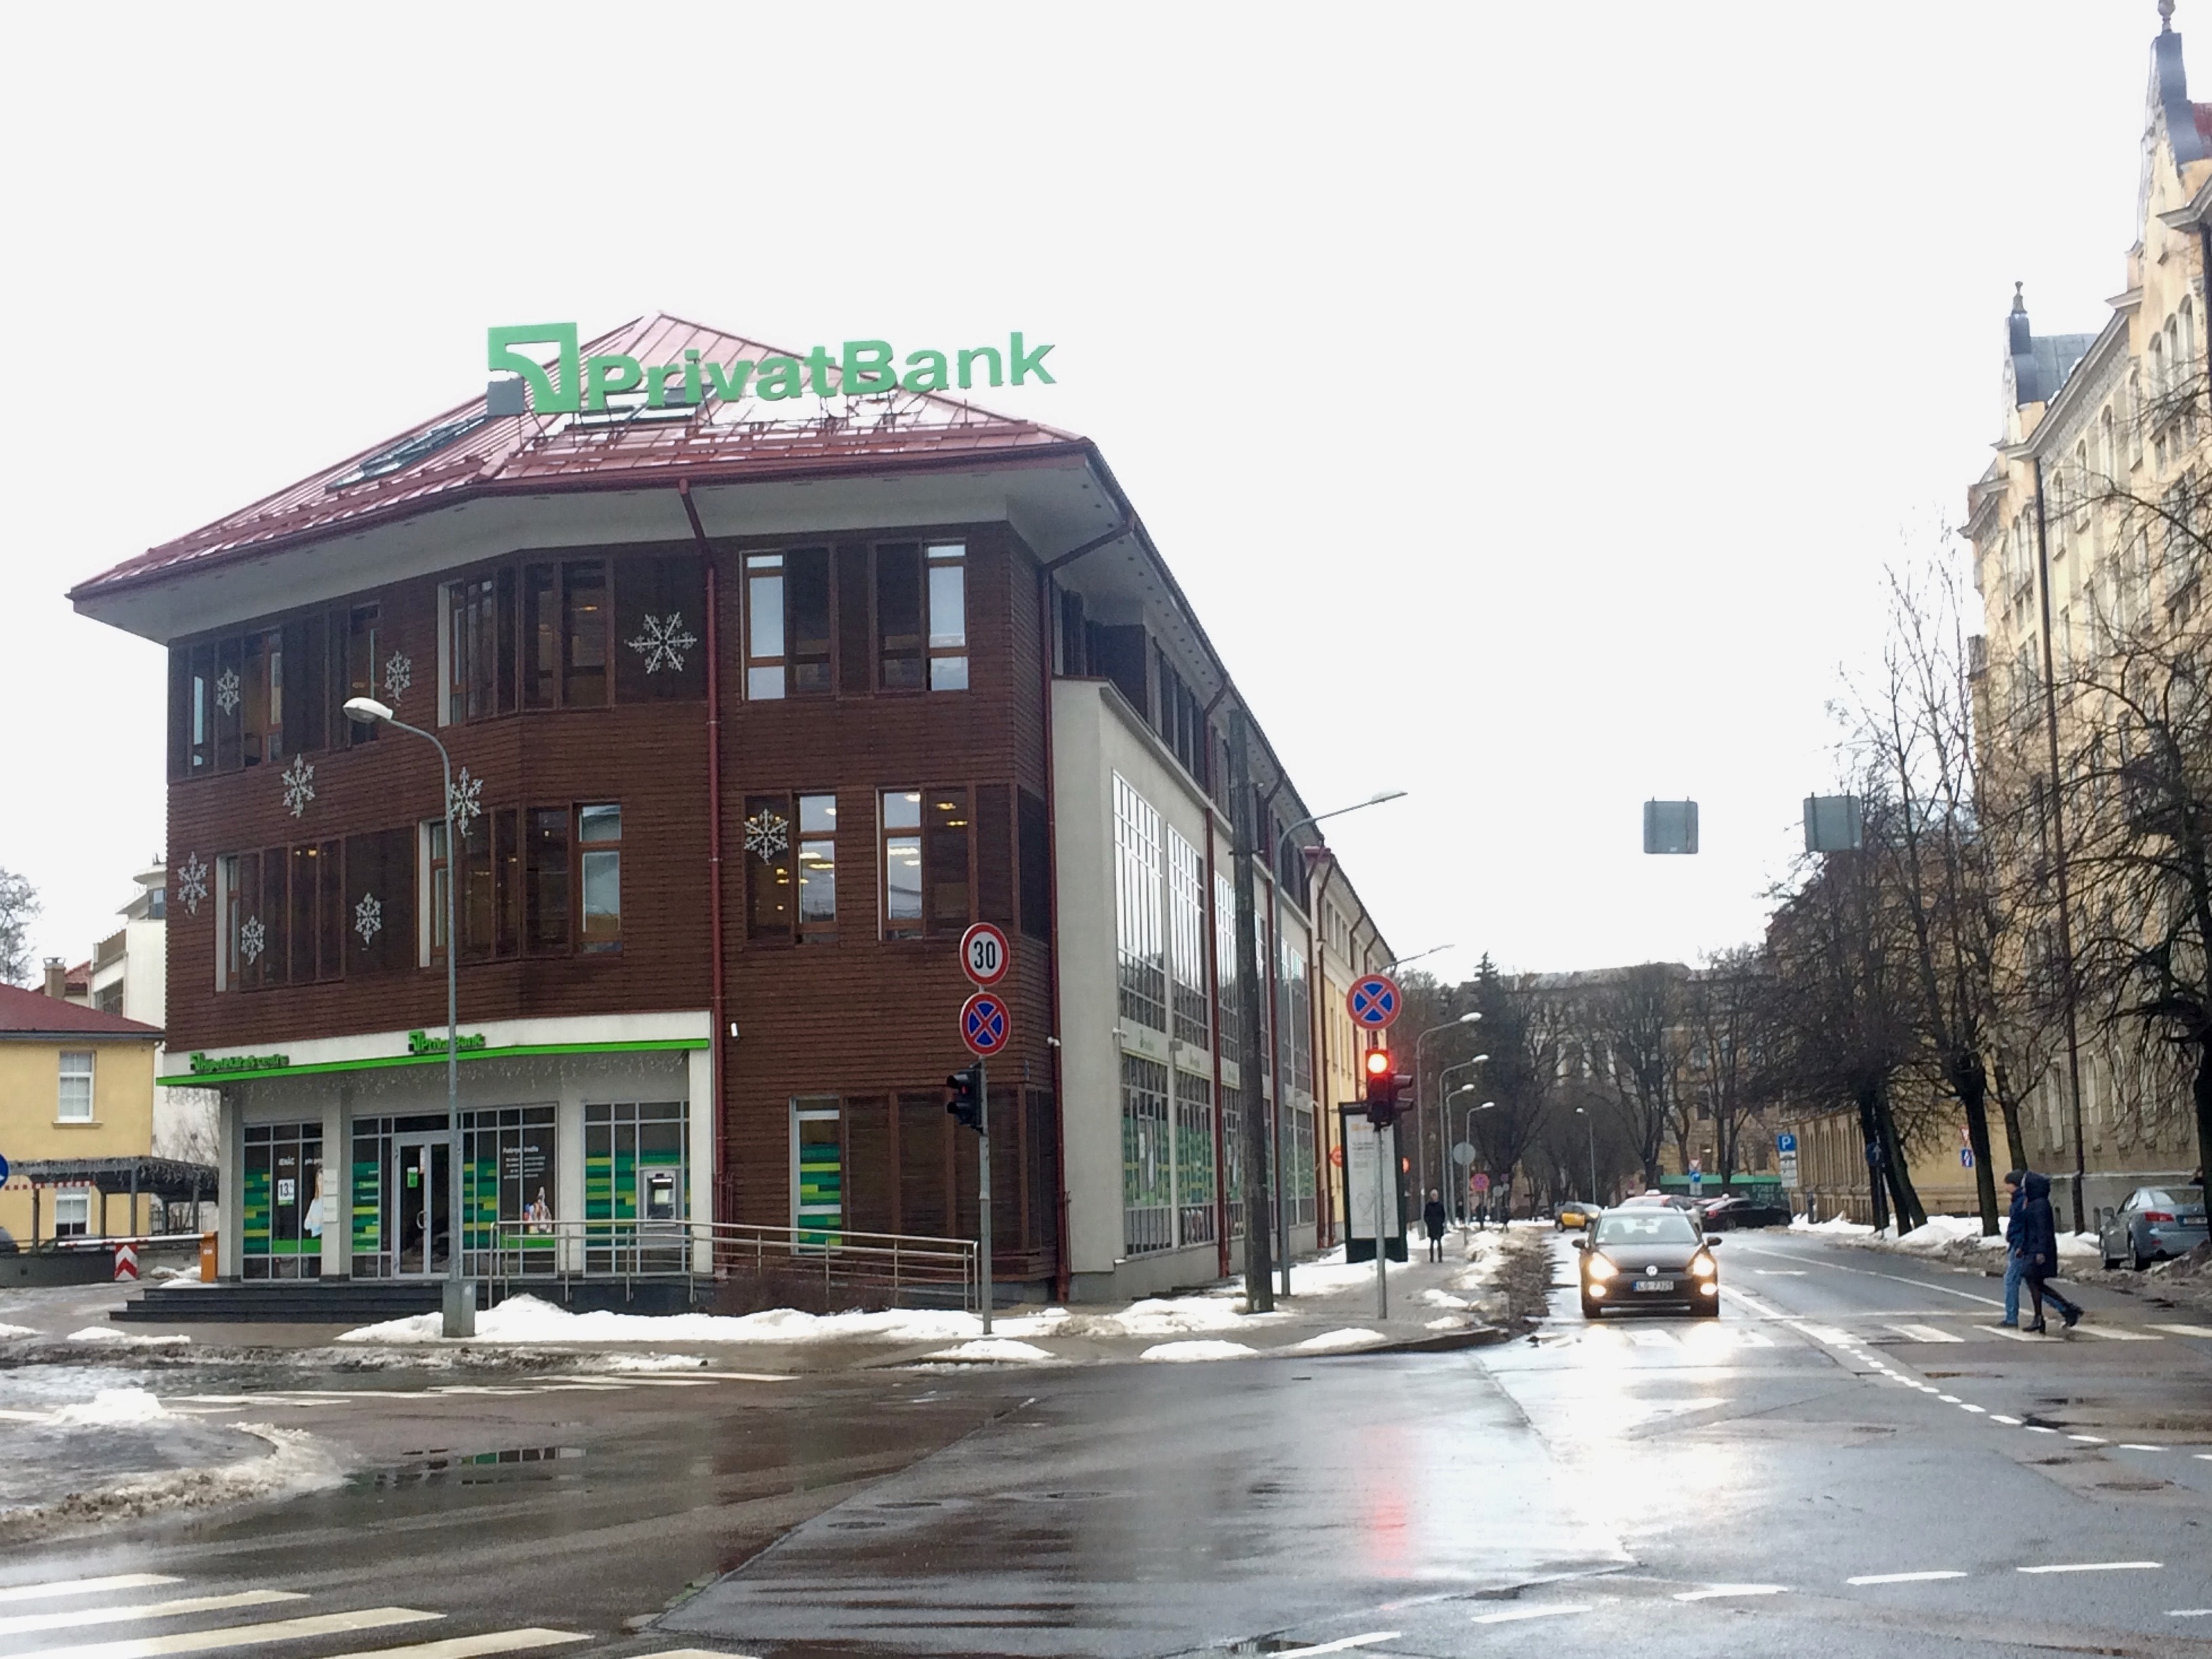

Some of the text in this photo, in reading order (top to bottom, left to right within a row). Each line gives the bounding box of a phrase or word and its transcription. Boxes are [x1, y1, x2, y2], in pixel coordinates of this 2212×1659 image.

[588, 332, 1056, 411] PrivatBank
[974, 941, 996, 969] 30
[420, 1033, 486, 1051] PrivaBank
[1781, 1136, 1791, 1150] P
